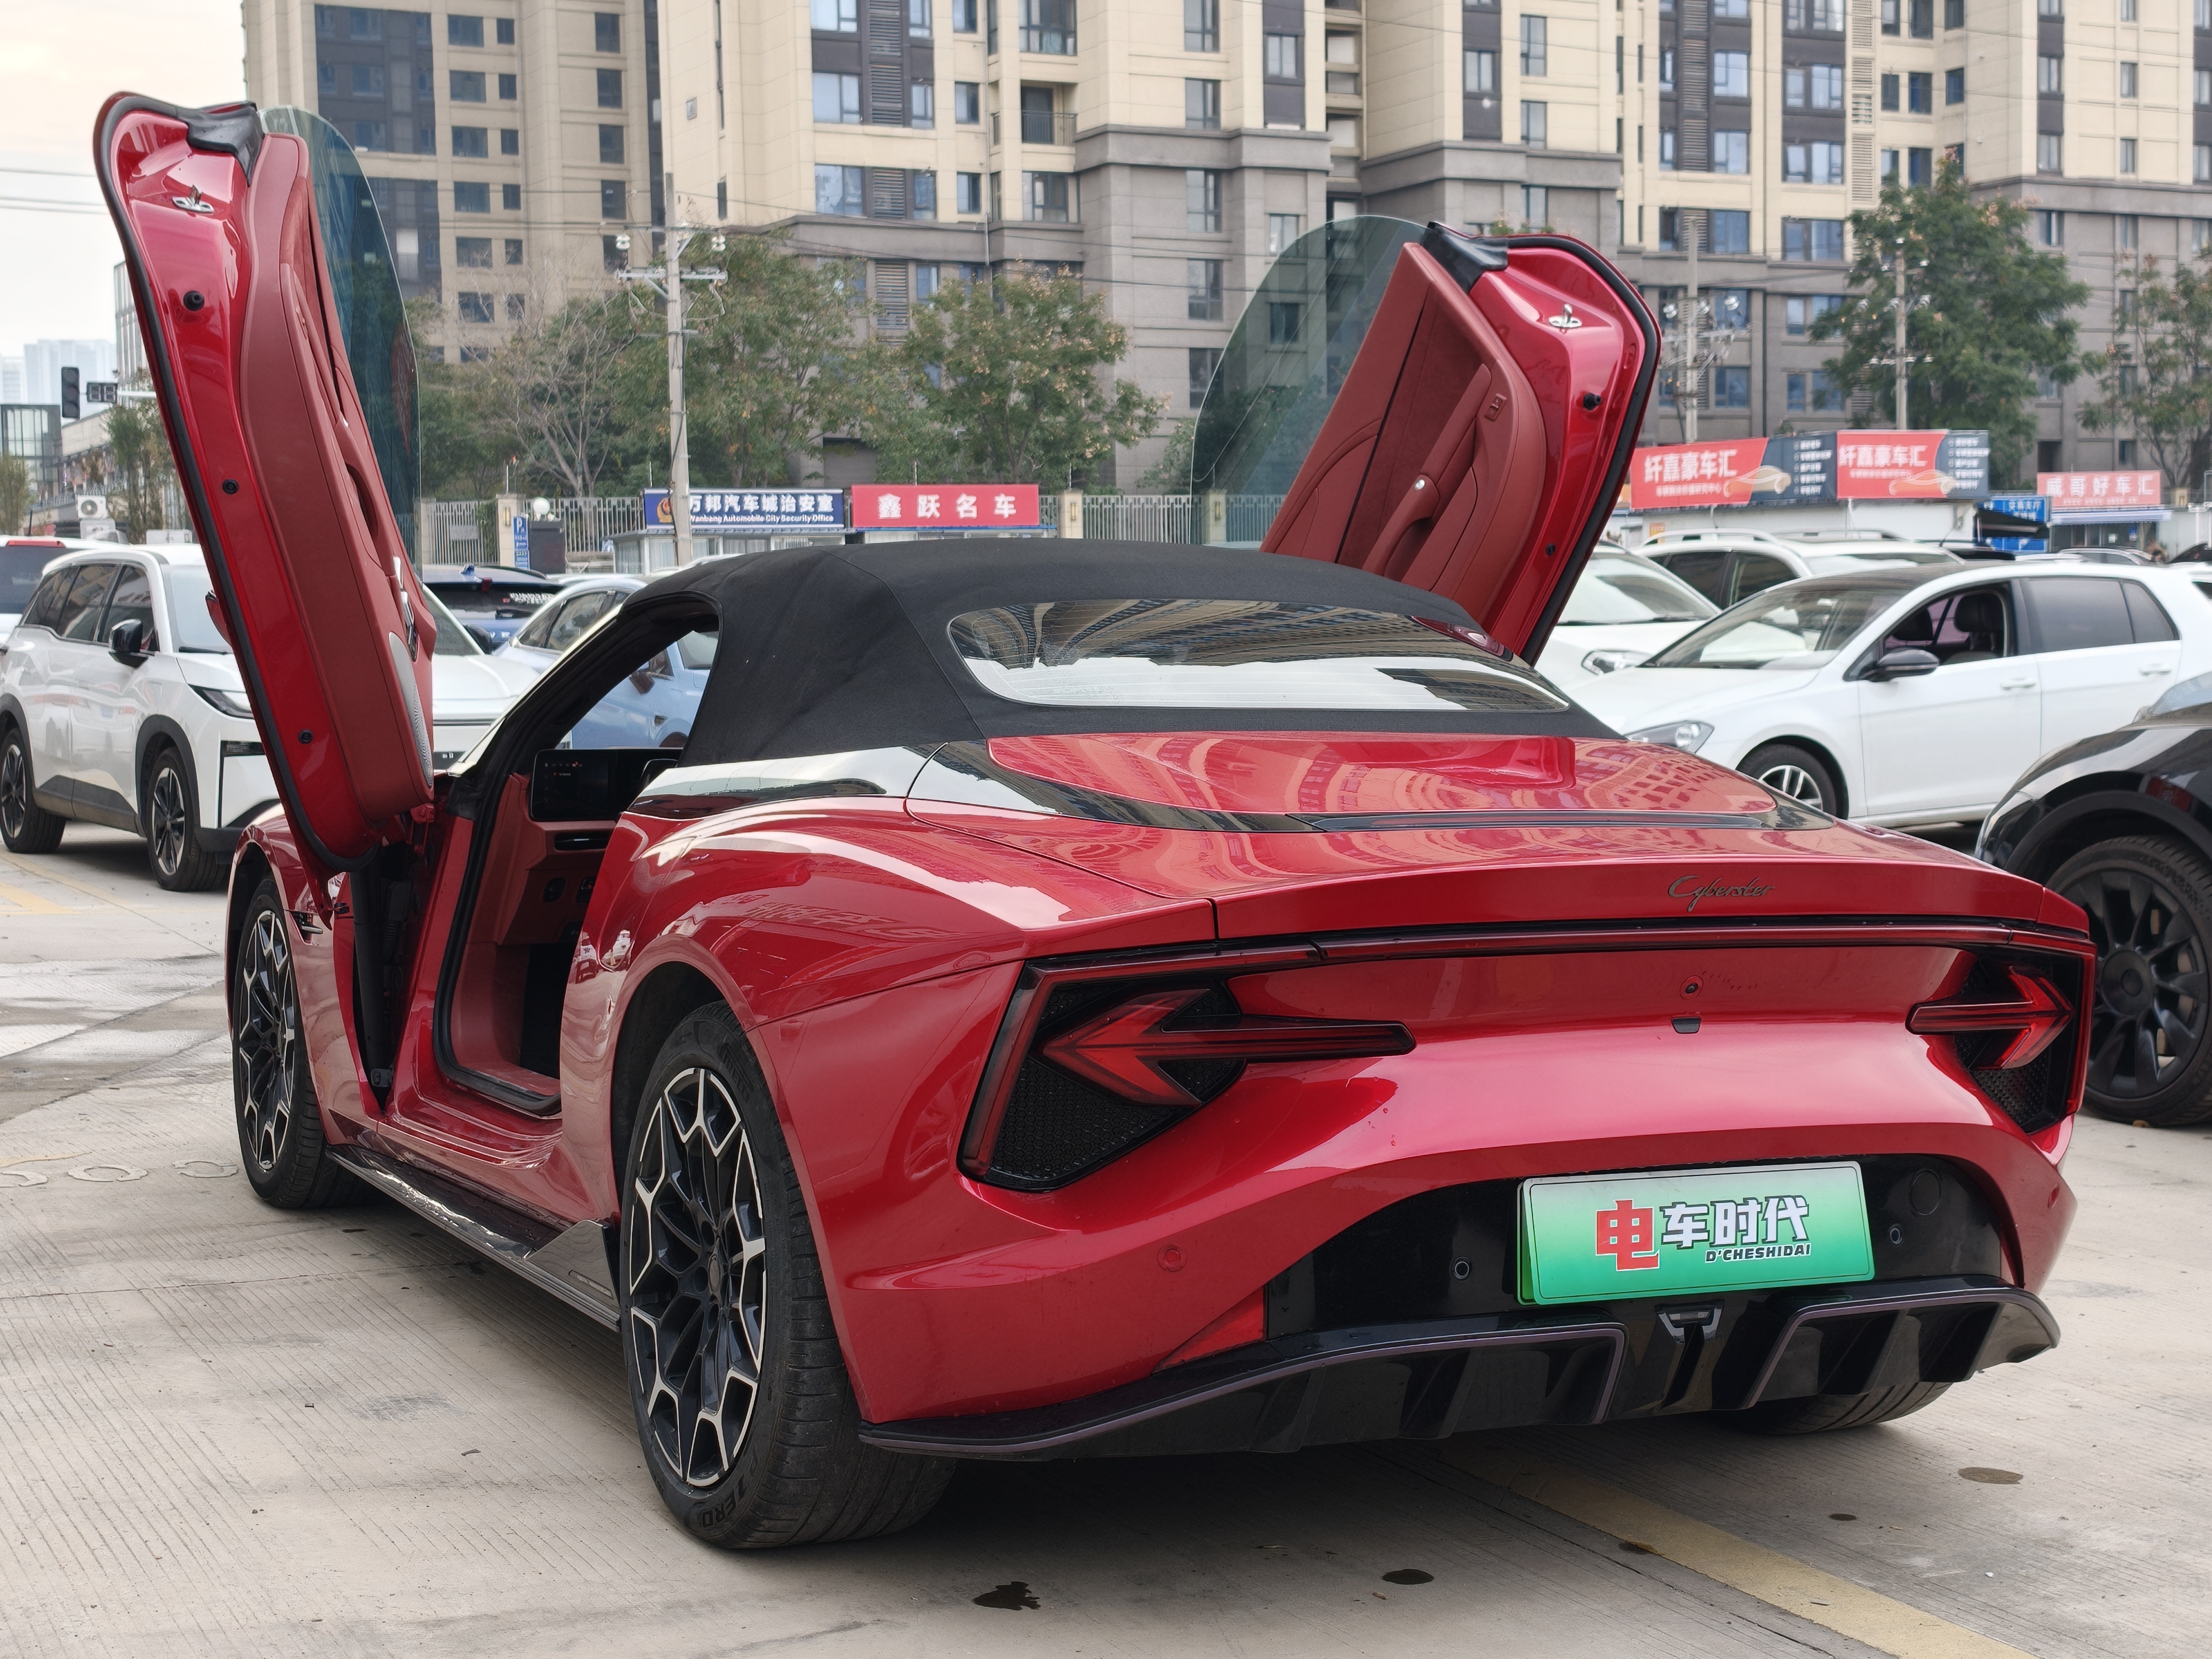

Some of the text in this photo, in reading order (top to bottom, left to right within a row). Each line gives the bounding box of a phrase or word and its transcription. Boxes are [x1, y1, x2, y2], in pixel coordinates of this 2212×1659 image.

[689, 494, 834, 512] 万邦汽车城治安室
[878, 494, 1017, 519] 鑫跃名车
[723, 514, 765, 522] Automobile
[766, 514, 780, 523] City
[781, 514, 811, 523] Security
[812, 514, 834, 522] Office
[1667, 875, 1776, 913] Cyberster
[1596, 1195, 1809, 1271] 电车时代
[1705, 1242, 1811, 1263] D'CHESHIDAI
